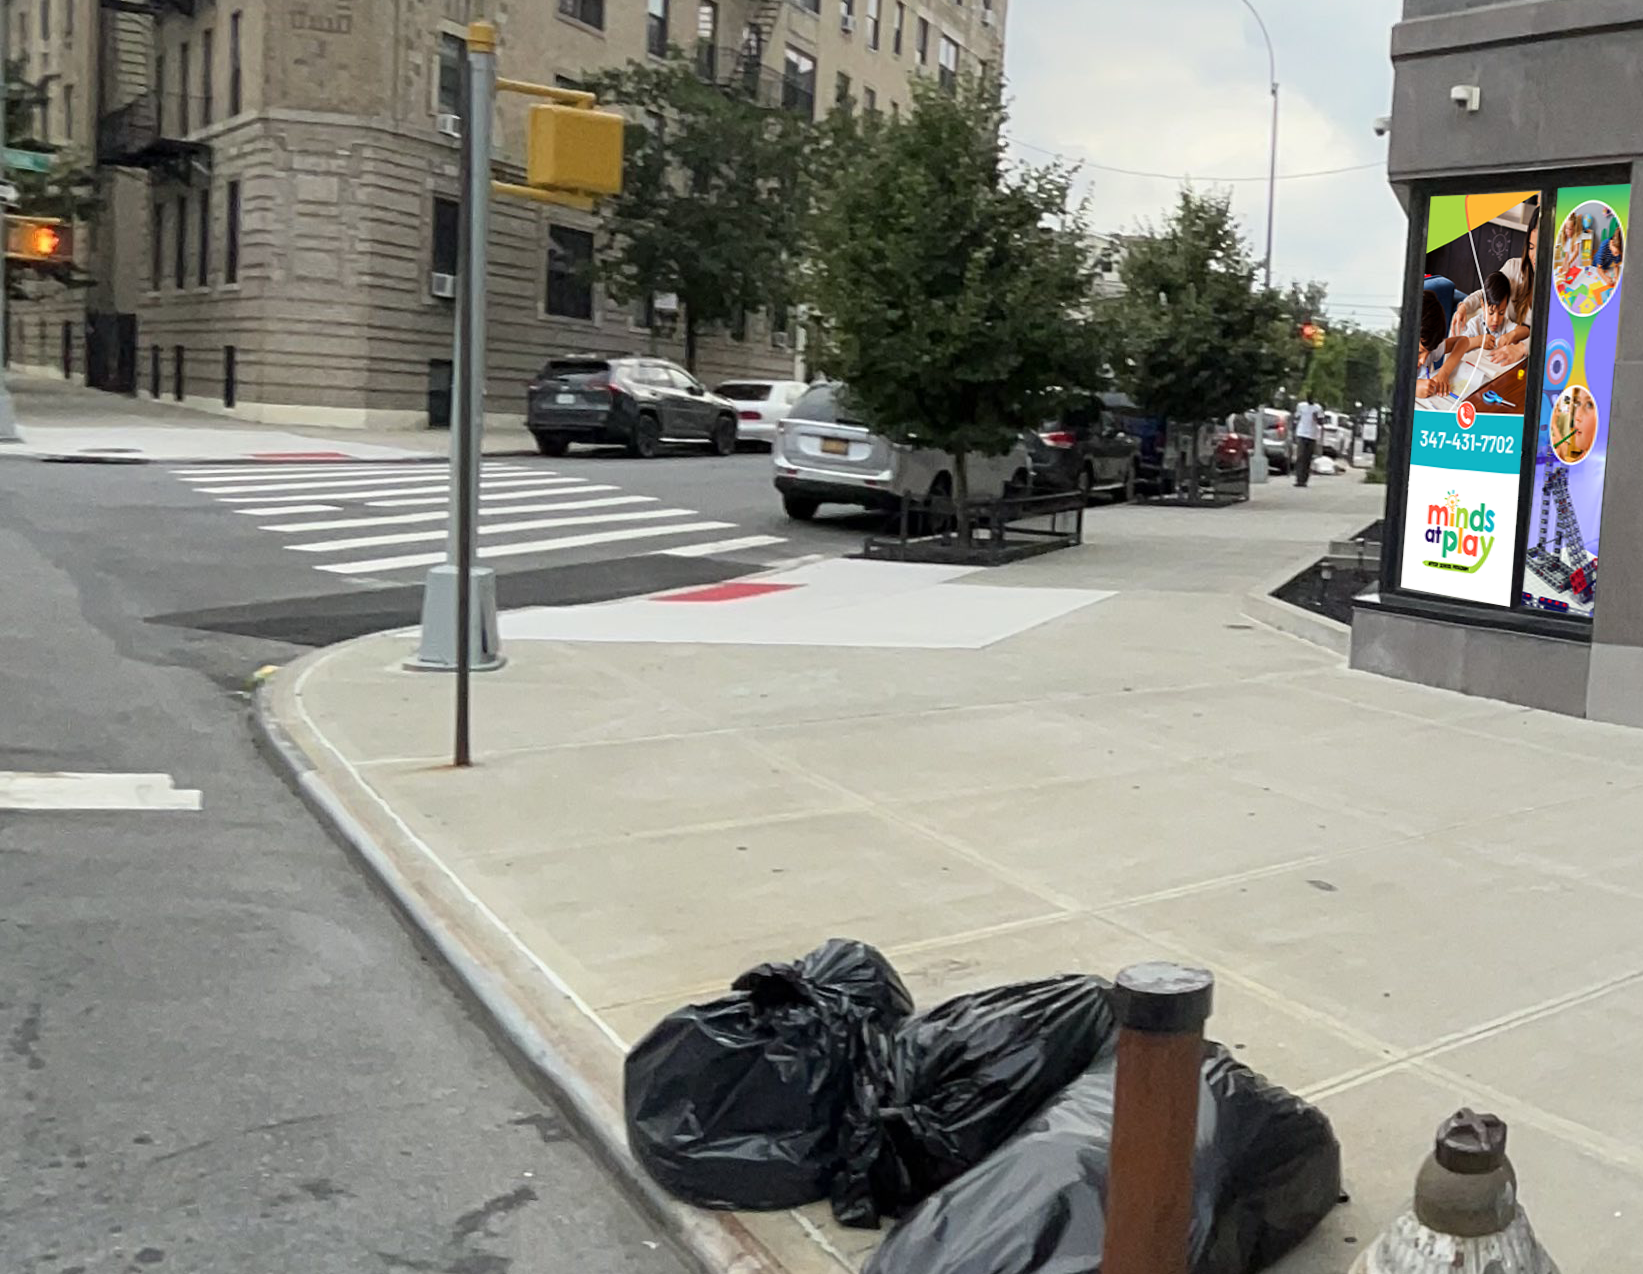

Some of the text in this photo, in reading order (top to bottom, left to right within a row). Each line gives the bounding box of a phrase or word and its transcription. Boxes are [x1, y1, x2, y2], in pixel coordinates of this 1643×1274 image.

[1419, 429, 1515, 455] 347-431-7702
[1427, 501, 1496, 533] minds
[1424, 525, 1496, 564] at play
